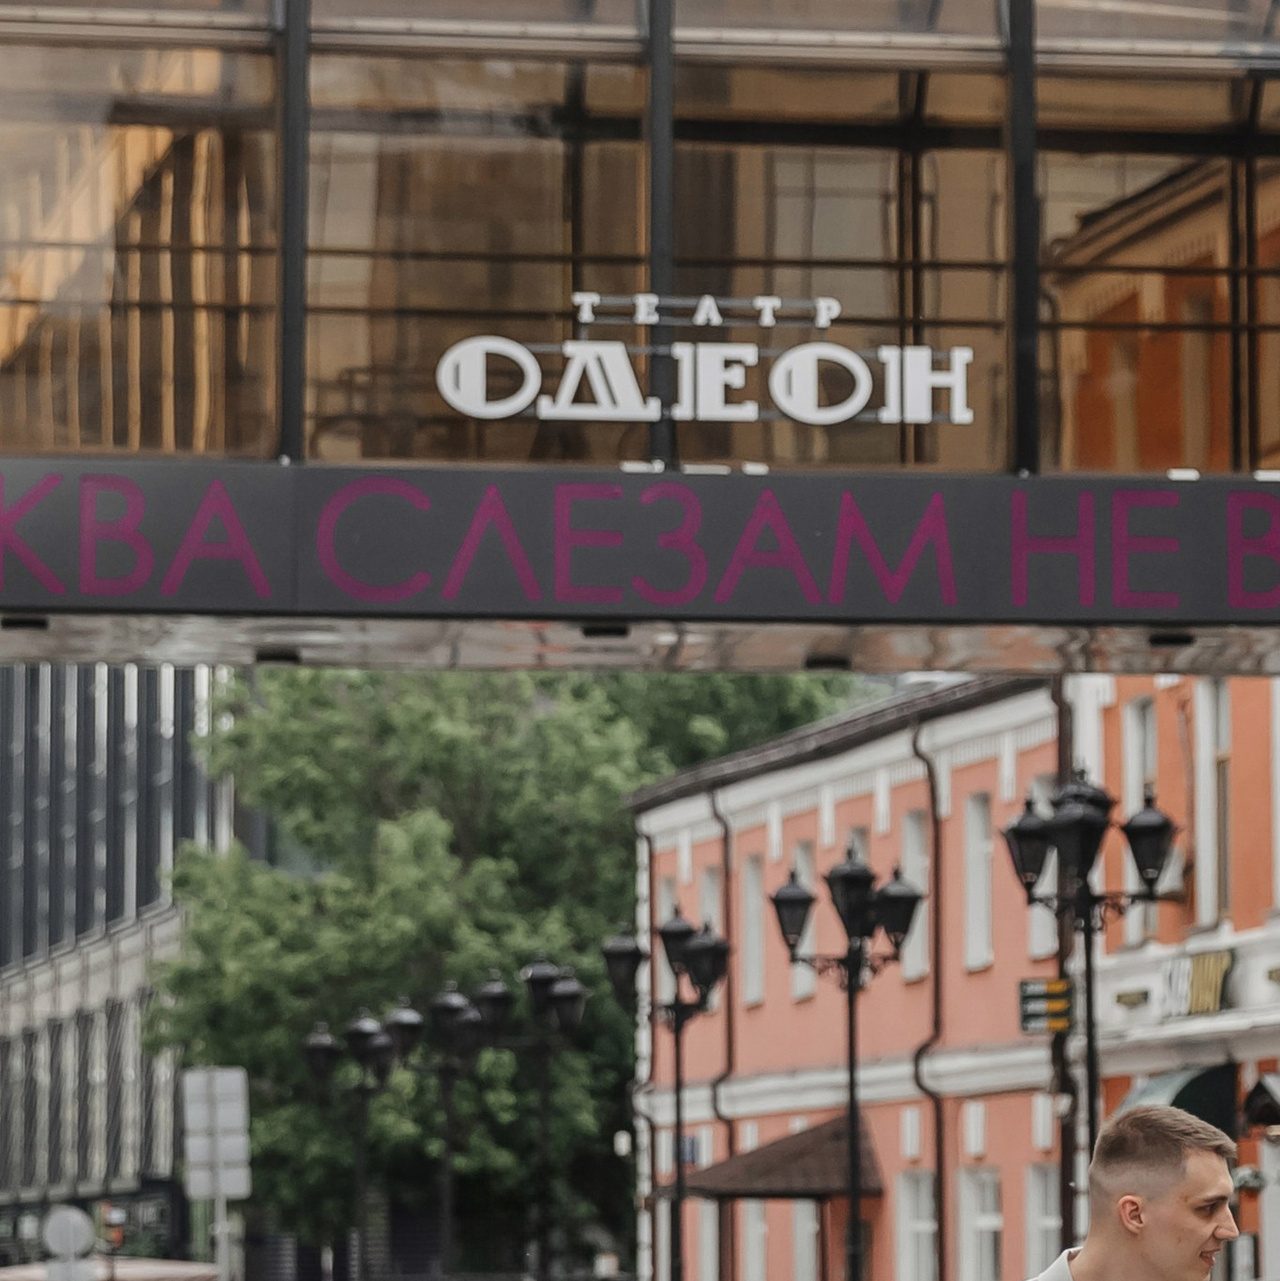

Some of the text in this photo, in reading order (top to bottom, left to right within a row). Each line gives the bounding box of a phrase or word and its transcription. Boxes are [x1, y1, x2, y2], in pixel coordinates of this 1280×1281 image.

[572, 291, 842, 328] ТЕАТР
[436, 335, 974, 425] ОДЕОН
[316, 475, 958, 606] СЛЕЗАМ
[1010, 489, 1181, 609] НЕ
